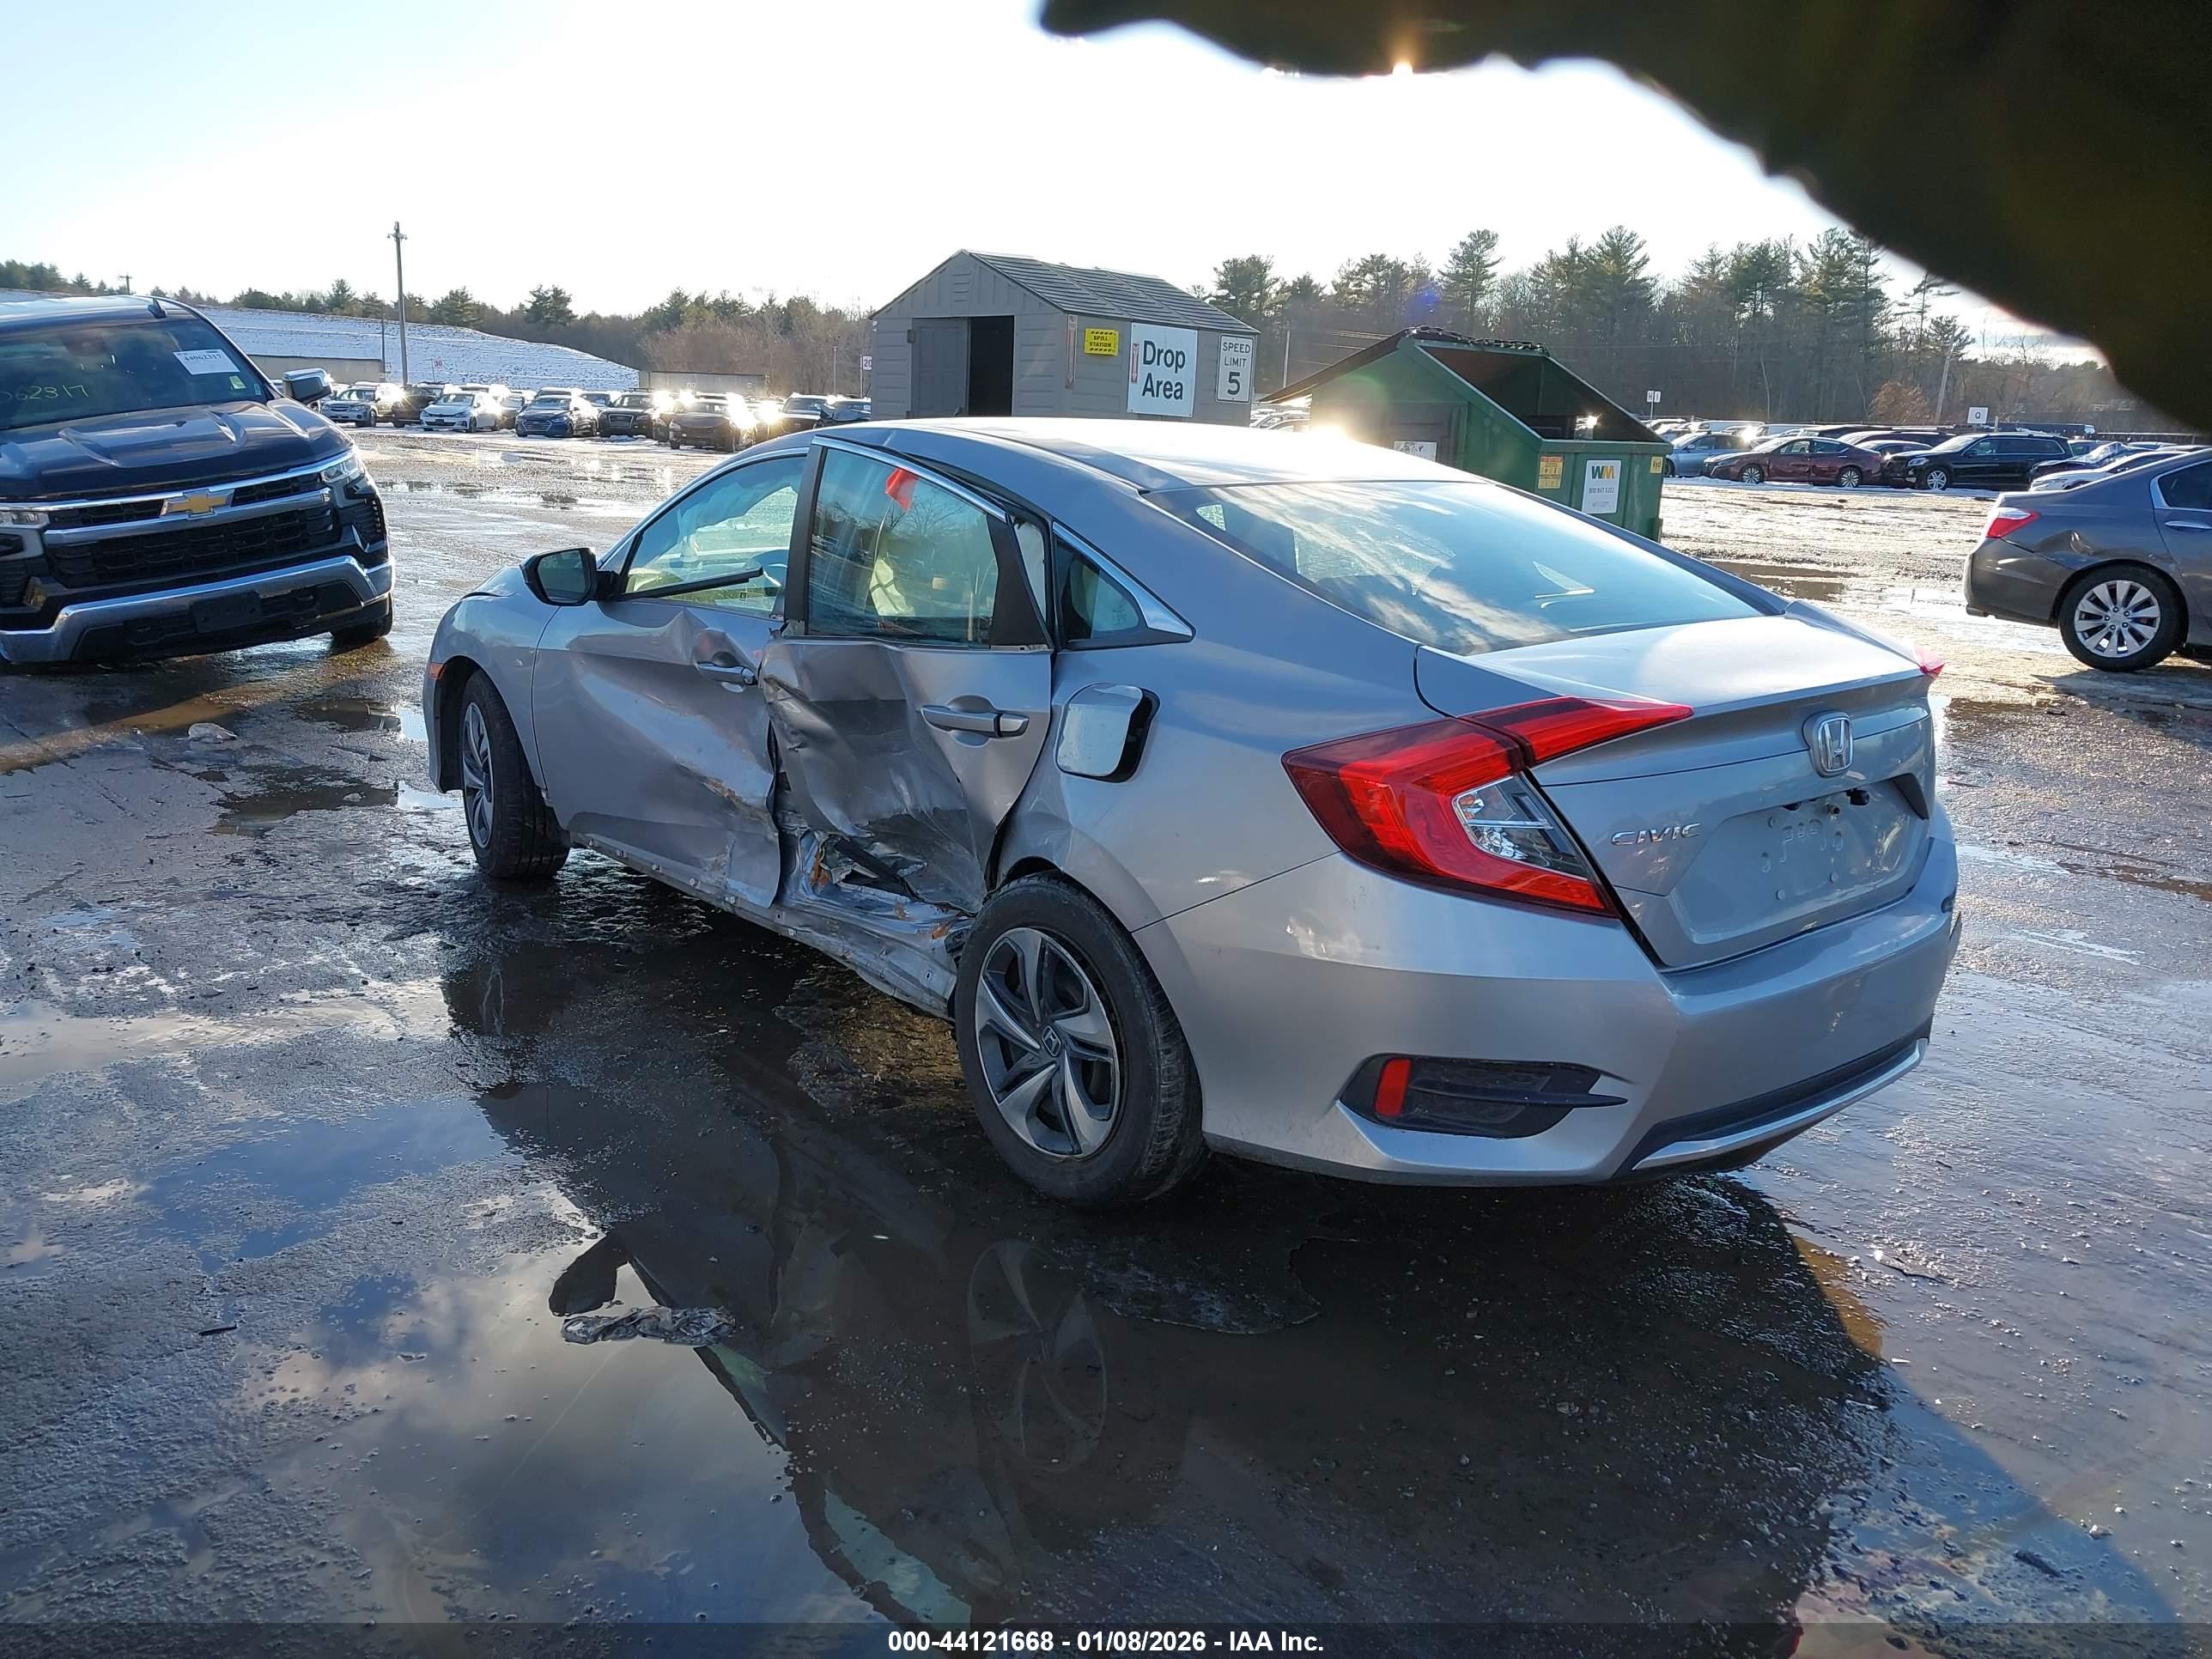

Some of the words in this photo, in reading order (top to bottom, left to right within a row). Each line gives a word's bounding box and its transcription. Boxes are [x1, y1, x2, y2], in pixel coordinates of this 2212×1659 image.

[1143, 340, 1186, 374] Drop
[1222, 342, 1251, 354] SPEED
[1224, 356, 1247, 368] LIMIT
[1141, 372, 1184, 401] Area
[1227, 371, 1241, 396] 5
[1591, 465, 1615, 479] WM
[1611, 822, 1702, 847] CIVIC
